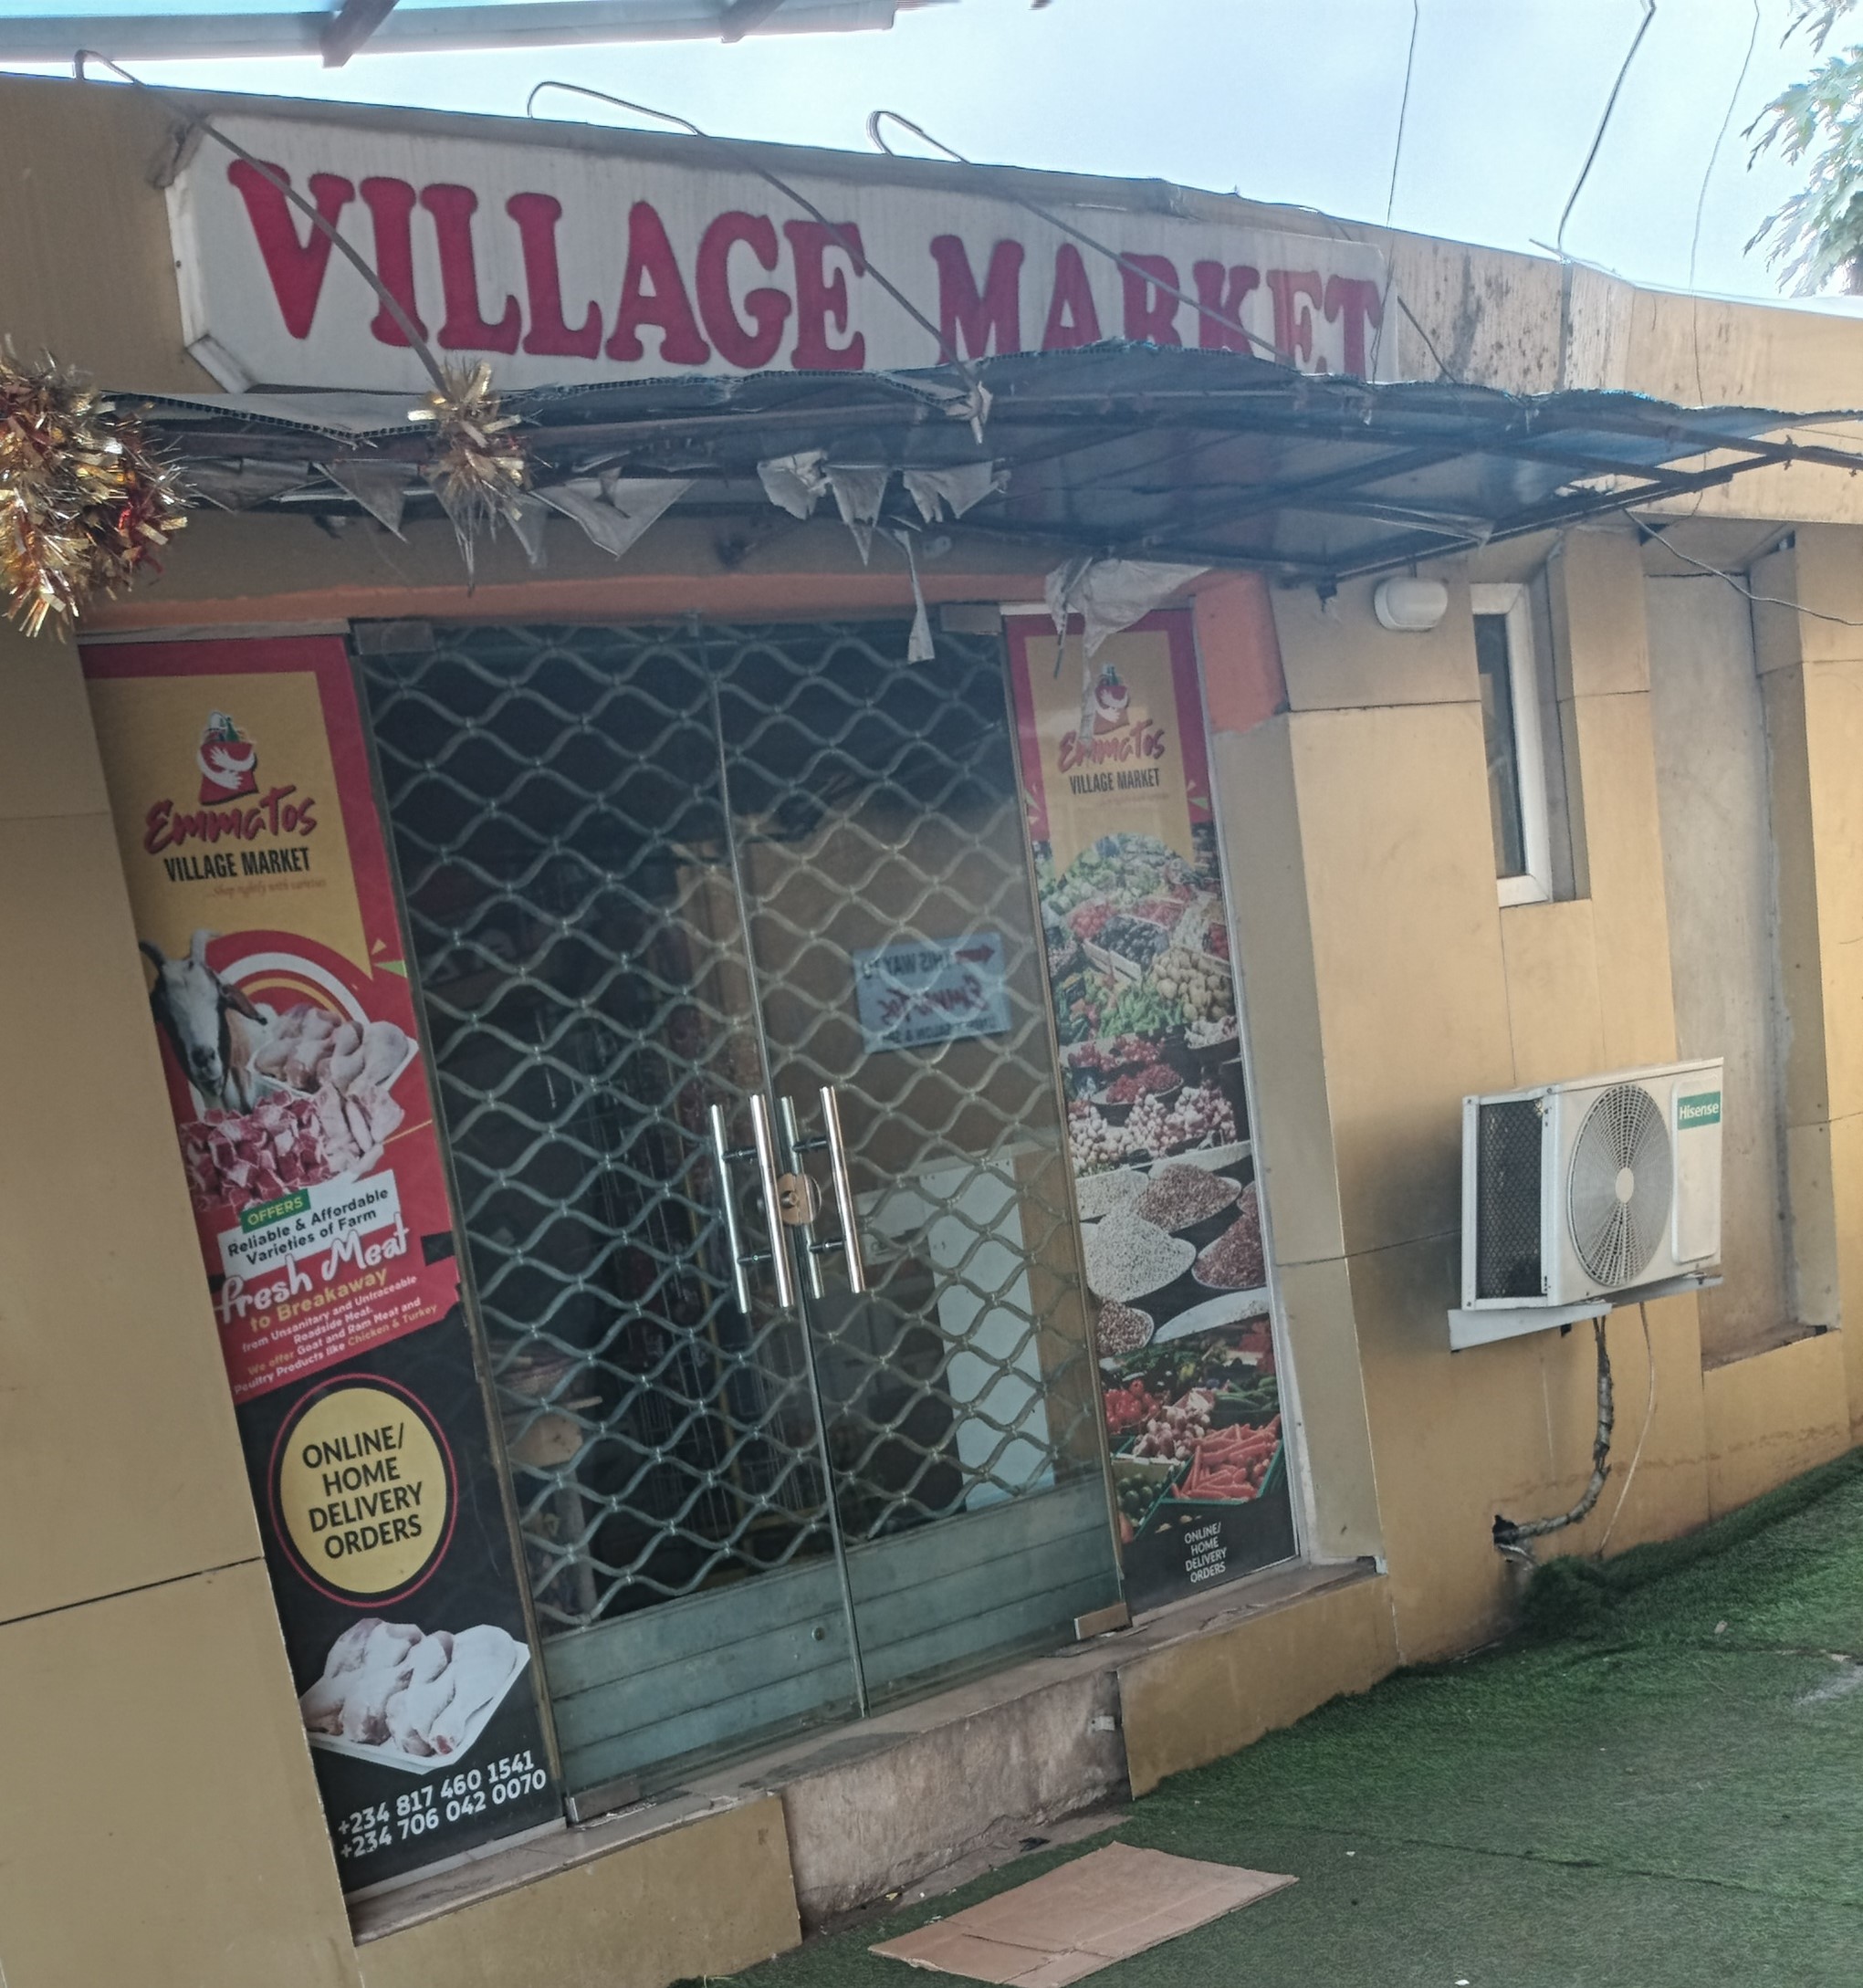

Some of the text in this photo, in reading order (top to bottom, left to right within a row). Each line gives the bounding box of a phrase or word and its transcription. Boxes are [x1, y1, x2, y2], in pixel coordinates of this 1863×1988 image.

[226, 159, 1383, 381] VILLAGE MARKET
[1070, 768, 1159, 795] VILLAGE MARKET
[163, 847, 310, 882] VILLAGE MARKET
[1680, 1104, 1720, 1120] Hisense
[228, 1188, 389, 1257] Reliable & Affordable
[247, 1196, 304, 1226] OFFERS
[246, 1209, 376, 1265] Varieties of Farm
[321, 1212, 409, 1280] Meat
[242, 1274, 418, 1353] from Unsanitary and Untraceable
[250, 1268, 388, 1333] to Breakaway
[234, 1303, 438, 1396] Poultry Products like Chicken & Turkey
[247, 1296, 421, 1376] We offer Goat and Ram Meat and
[293, 1316, 343, 1345] Roadside
[302, 1422, 404, 1469] ONLINE/
[322, 1457, 400, 1497] HOME
[309, 1481, 422, 1533] DELIVERY
[324, 1514, 422, 1559] ORDERS
[1184, 1522, 1221, 1544] ONLINE/
[1190, 1536, 1219, 1556] HOME
[1186, 1547, 1227, 1572] DELIVERY
[1190, 1561, 1226, 1584] ORDERS
[338, 1750, 534, 1836] +234 817 460 1541
[340, 1769, 546, 1858] +234 706 042 0070
